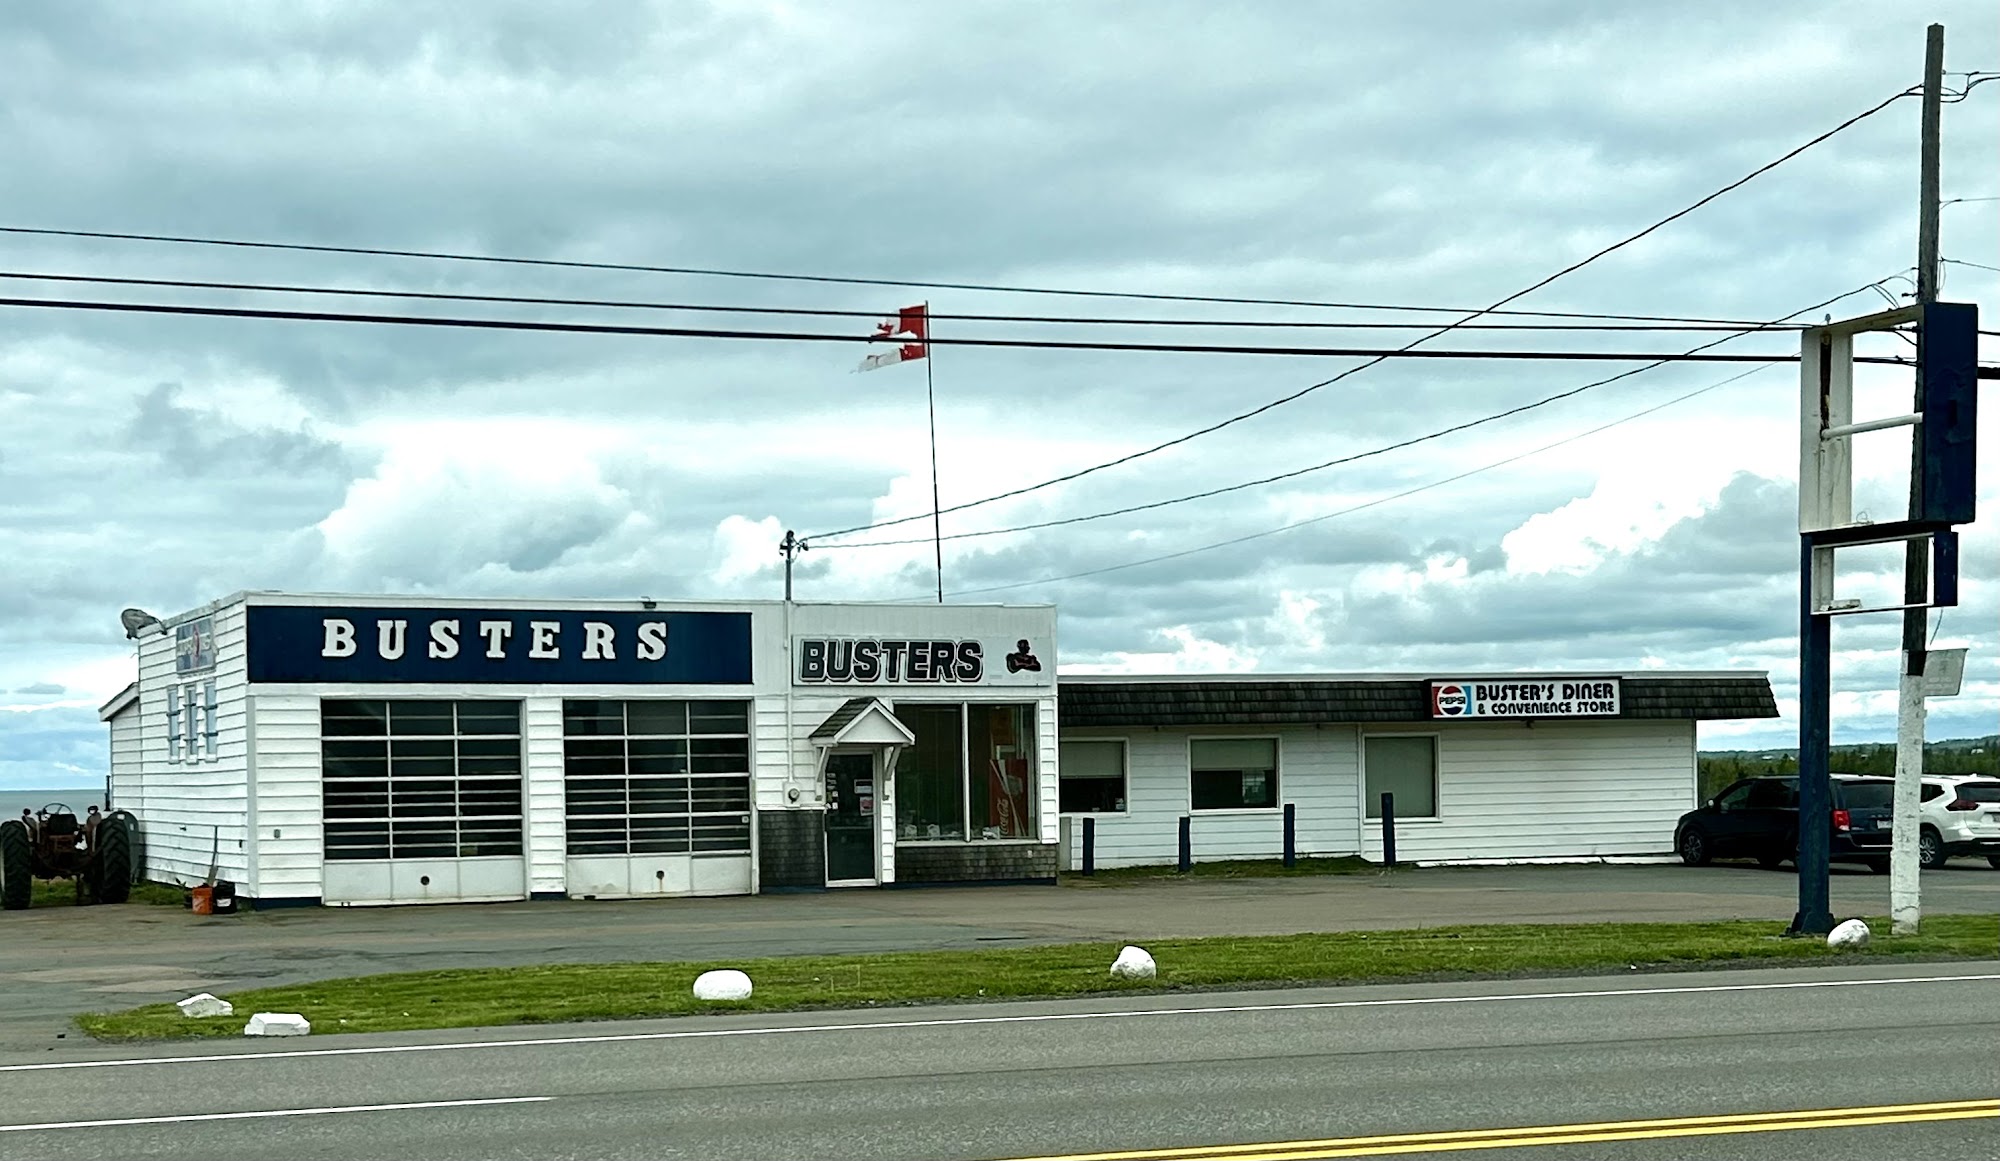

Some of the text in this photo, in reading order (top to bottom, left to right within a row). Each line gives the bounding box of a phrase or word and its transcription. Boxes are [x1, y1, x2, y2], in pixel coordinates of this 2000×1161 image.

[321, 618, 669, 661] BUSTERS
[800, 638, 984, 682] BUSTERS
[1439, 696, 1466, 705] PEPSI
[1476, 683, 1614, 701] BUSTER'S DINER
[1478, 702, 1614, 715] & CONVENIENCE STORE
